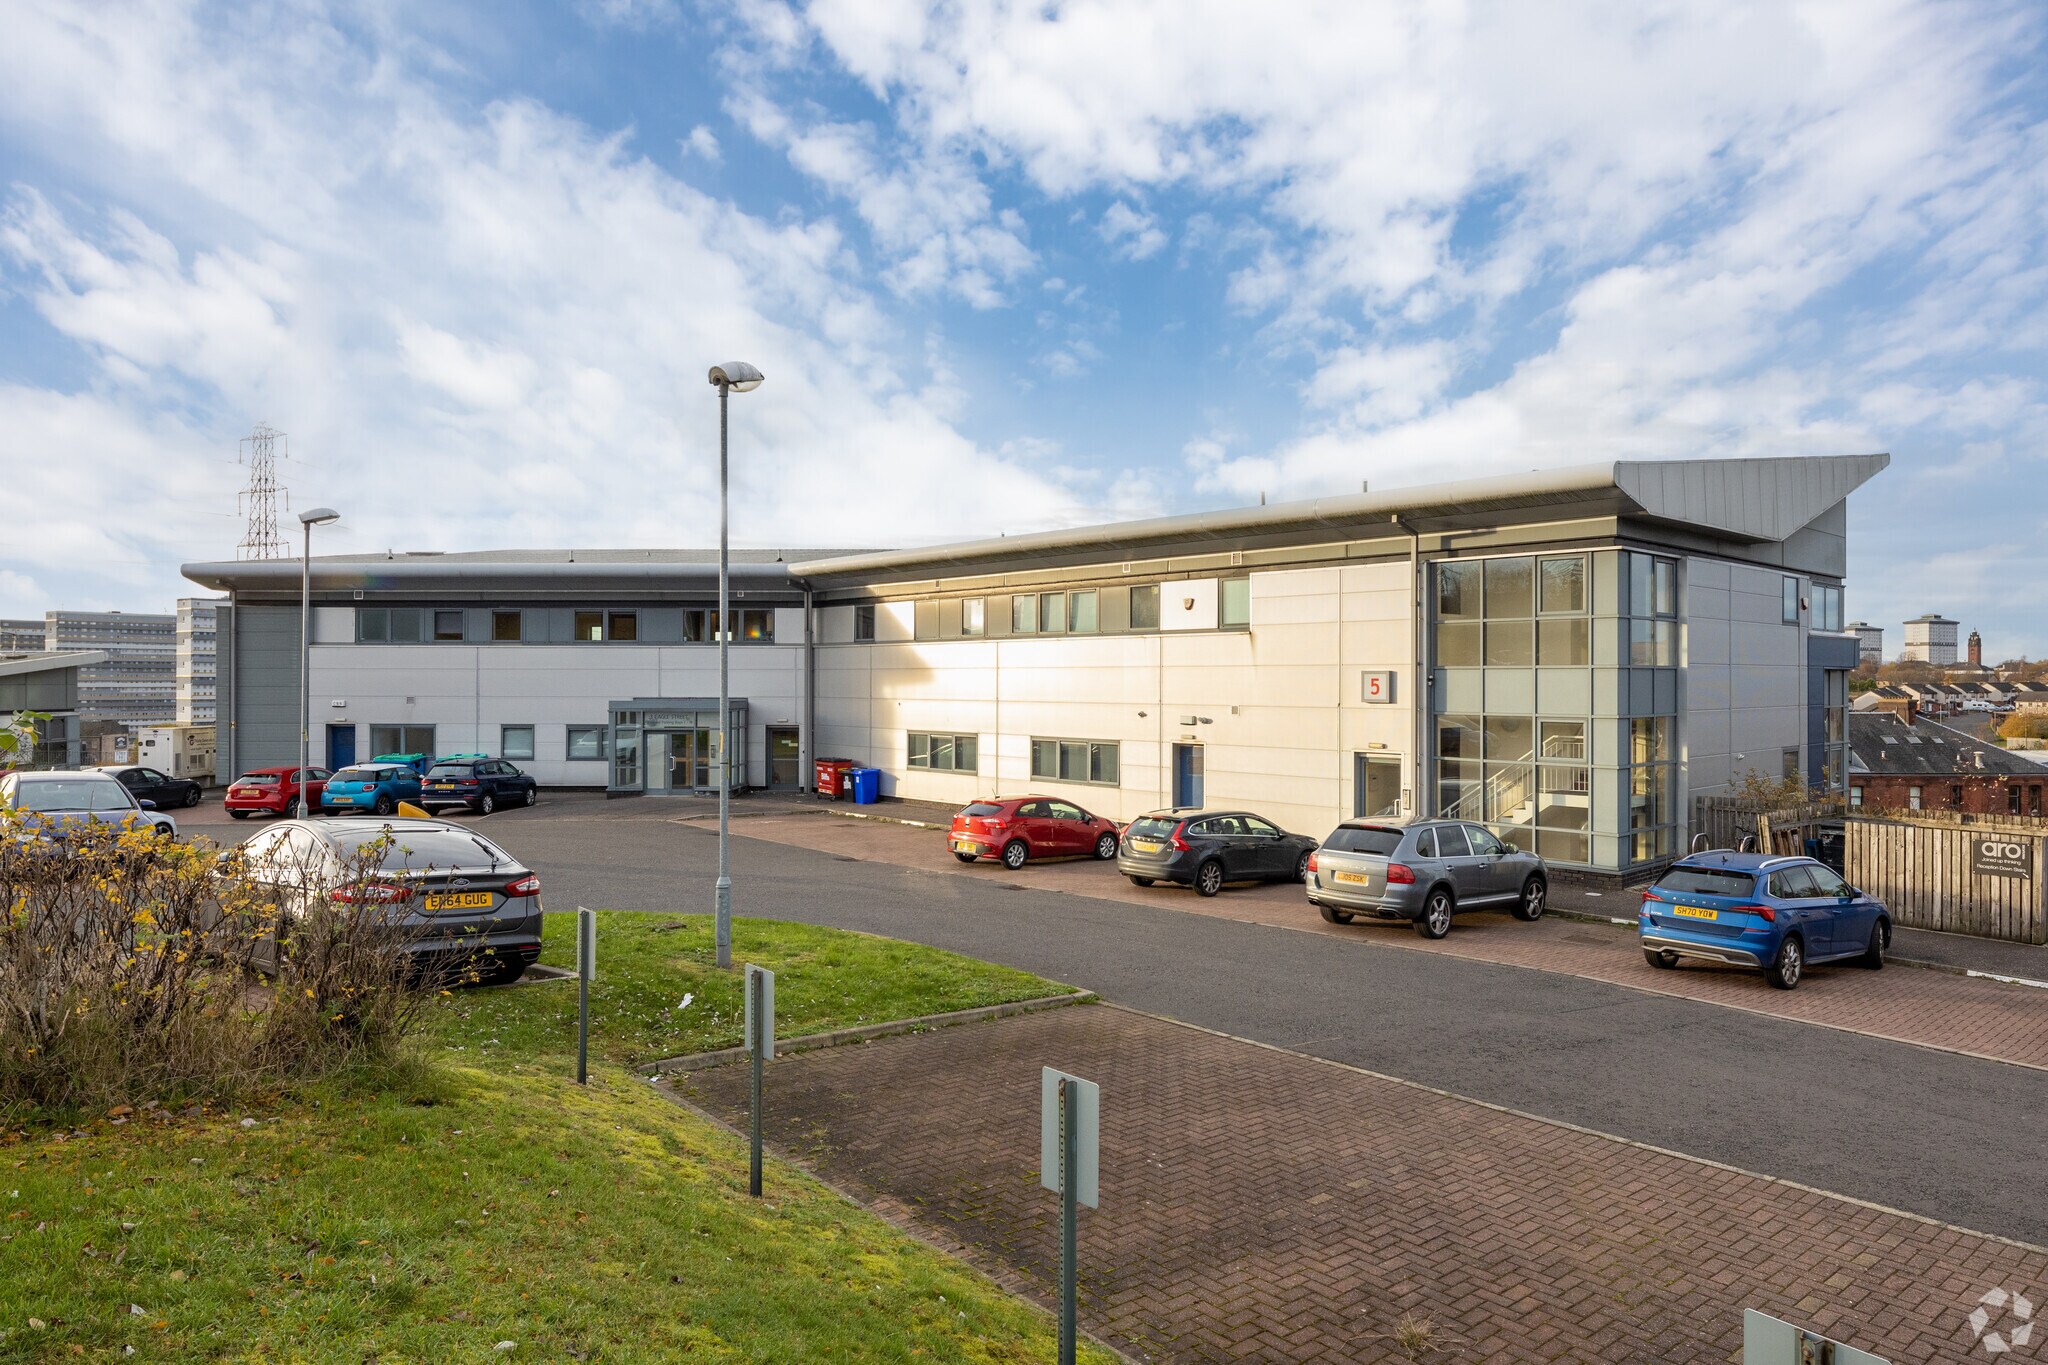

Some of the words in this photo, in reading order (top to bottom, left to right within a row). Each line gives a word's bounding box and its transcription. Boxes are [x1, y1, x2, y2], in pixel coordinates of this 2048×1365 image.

[1371, 678, 1380, 695] 5
[1352, 875, 1364, 884] ZSK
[465, 894, 487, 905] GUG
[1677, 906, 1697, 916] SH70
